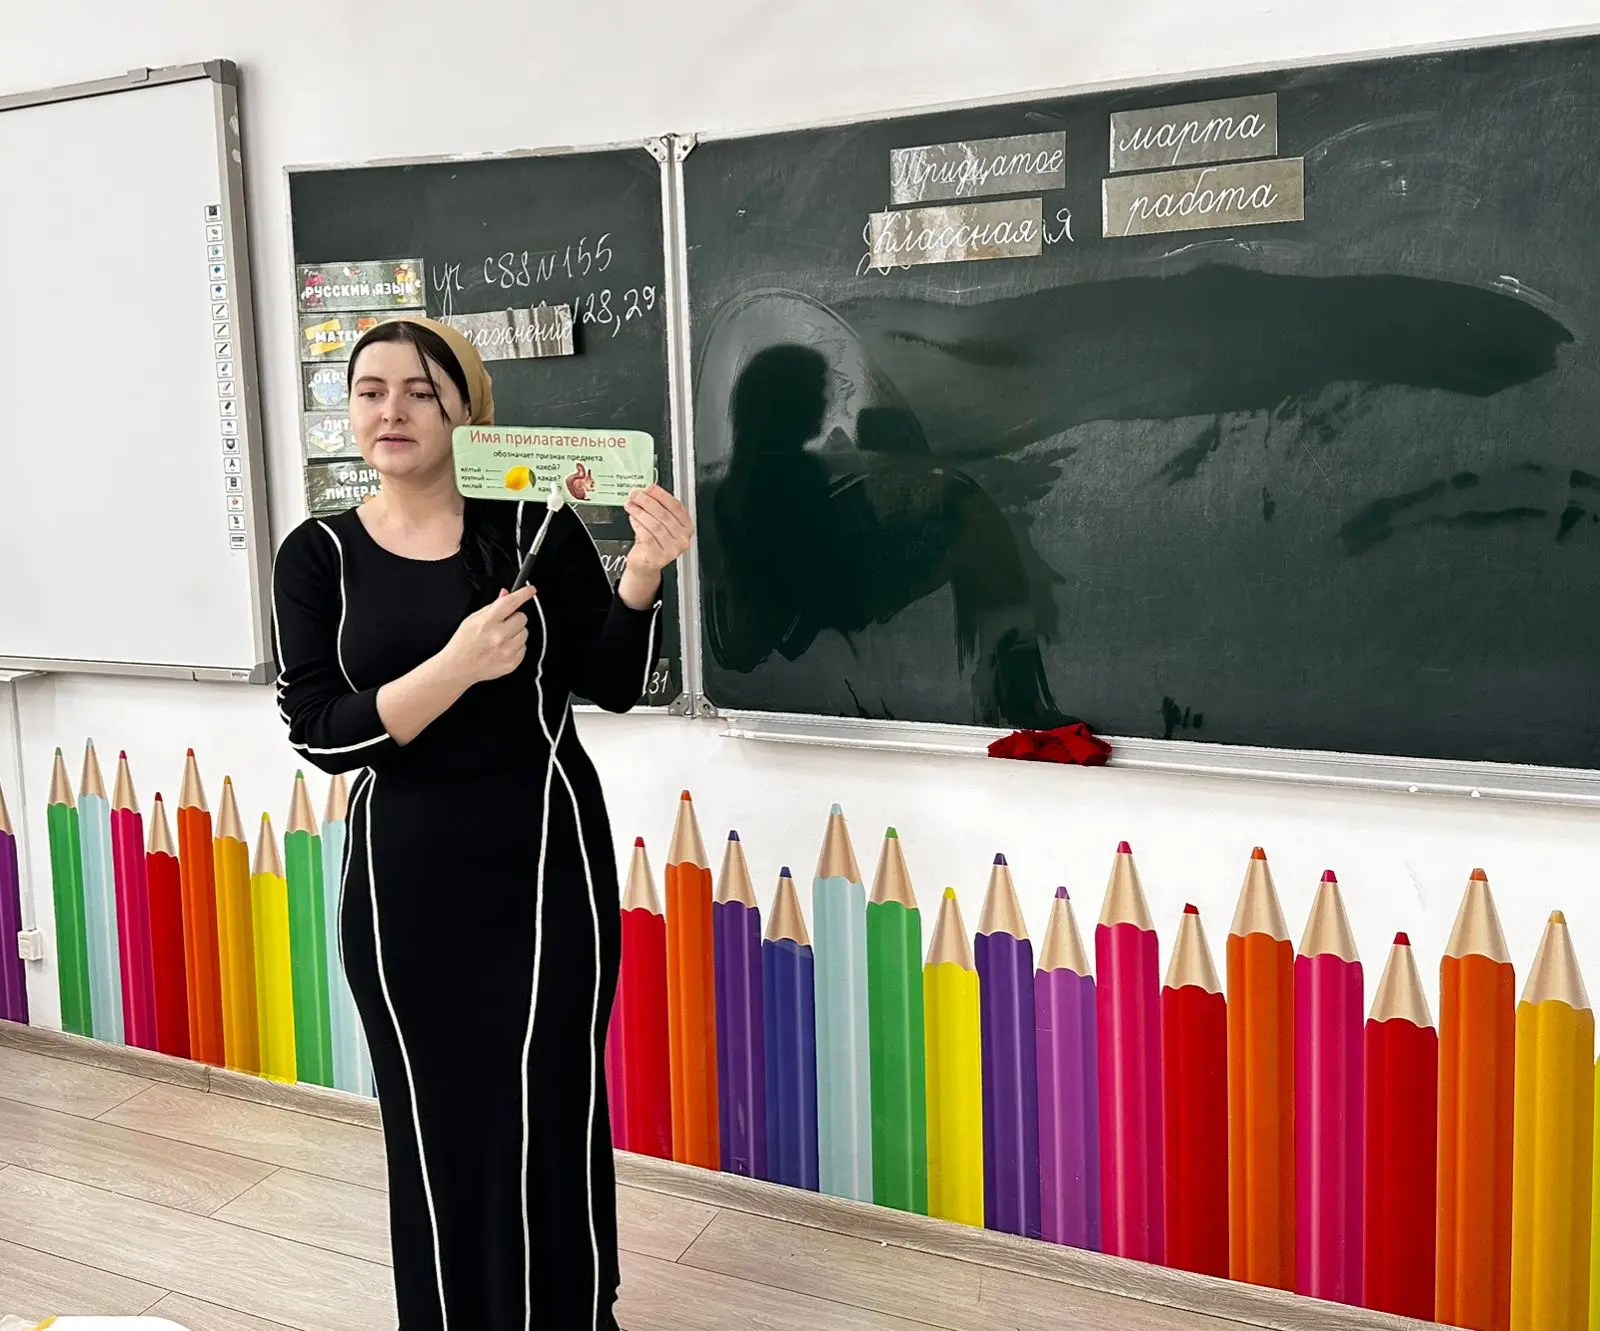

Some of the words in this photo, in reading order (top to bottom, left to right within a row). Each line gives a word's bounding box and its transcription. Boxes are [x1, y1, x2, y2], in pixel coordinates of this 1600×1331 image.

[1119, 110, 1266, 165] марта
[1124, 169, 1278, 236] работа
[872, 209, 1041, 254] Классная
[305, 280, 370, 298] РУССКИЙ
[374, 282, 414, 296] ЯЗЫК
[315, 330, 363, 343] МАТЕМ
[313, 371, 348, 386] ОКРУ
[323, 418, 351, 432] ЛИТ
[470, 430, 501, 443] Имя
[506, 433, 626, 450] прилагательное
[493, 450, 534, 459] обозначает
[535, 453, 565, 461] признак
[567, 454, 603, 463] предмета
[340, 468, 379, 483] РОДН
